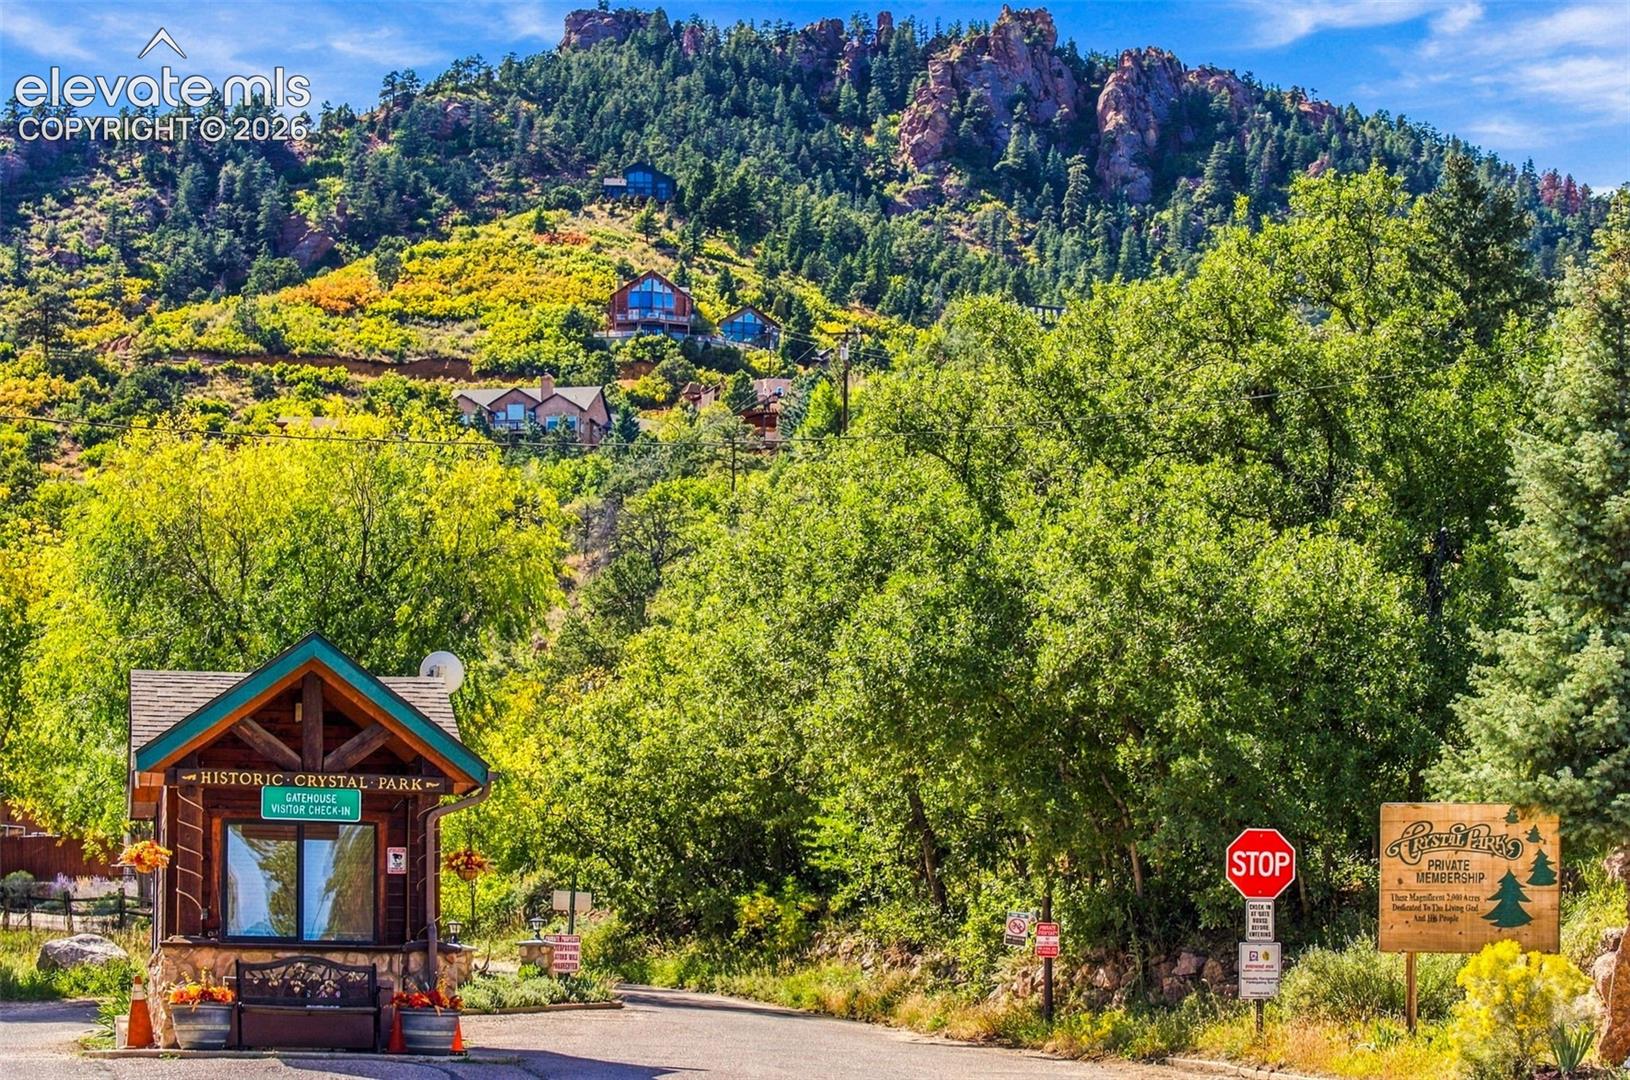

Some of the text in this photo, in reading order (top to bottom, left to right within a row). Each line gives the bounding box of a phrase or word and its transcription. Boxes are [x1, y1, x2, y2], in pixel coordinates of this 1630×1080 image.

[200, 771, 423, 790] HISTORIC CRYSTAL PARK
[285, 793, 337, 804] GATEHOUSE
[271, 804, 351, 816] VISITOR CHECK-IN
[1231, 850, 1291, 877] STOP
[1427, 859, 1470, 871] PRIVATE
[1416, 872, 1485, 884] MEMBERSHIP
[1464, 893, 1481, 902] Acres
[1392, 903, 1422, 912] Dedicated
[1423, 903, 1431, 912] To
[1445, 903, 1464, 913] Living
